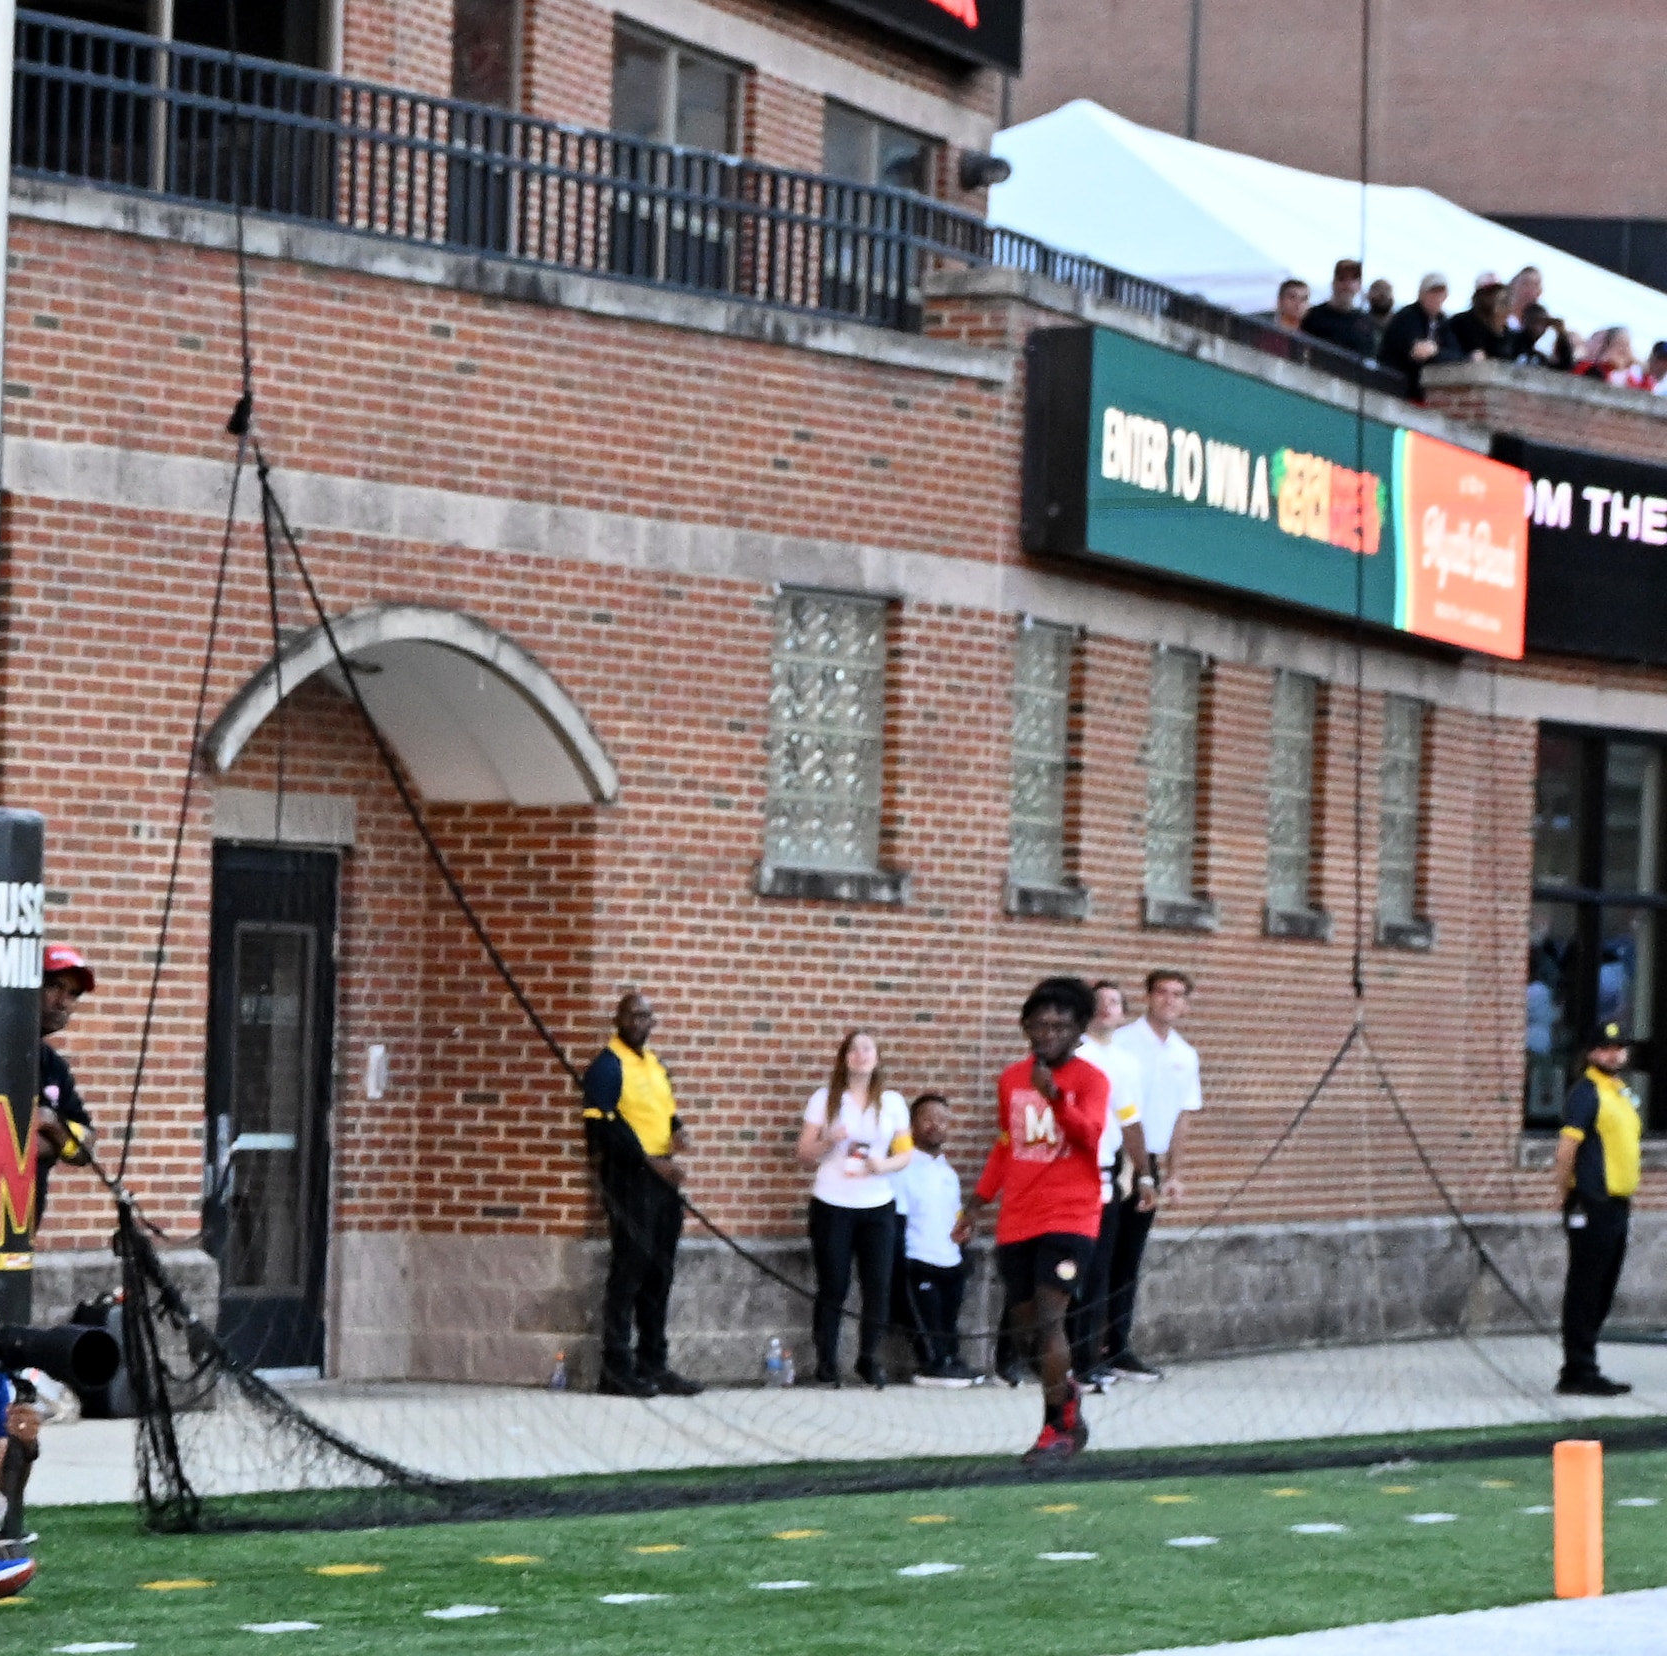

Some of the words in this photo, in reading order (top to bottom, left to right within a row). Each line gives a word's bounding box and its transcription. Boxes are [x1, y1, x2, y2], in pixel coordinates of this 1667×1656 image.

[1172, 427, 1203, 502] TO
[1249, 455, 1269, 521] A
[1582, 485, 1667, 546] THE
[1025, 1104, 1056, 1145] M
